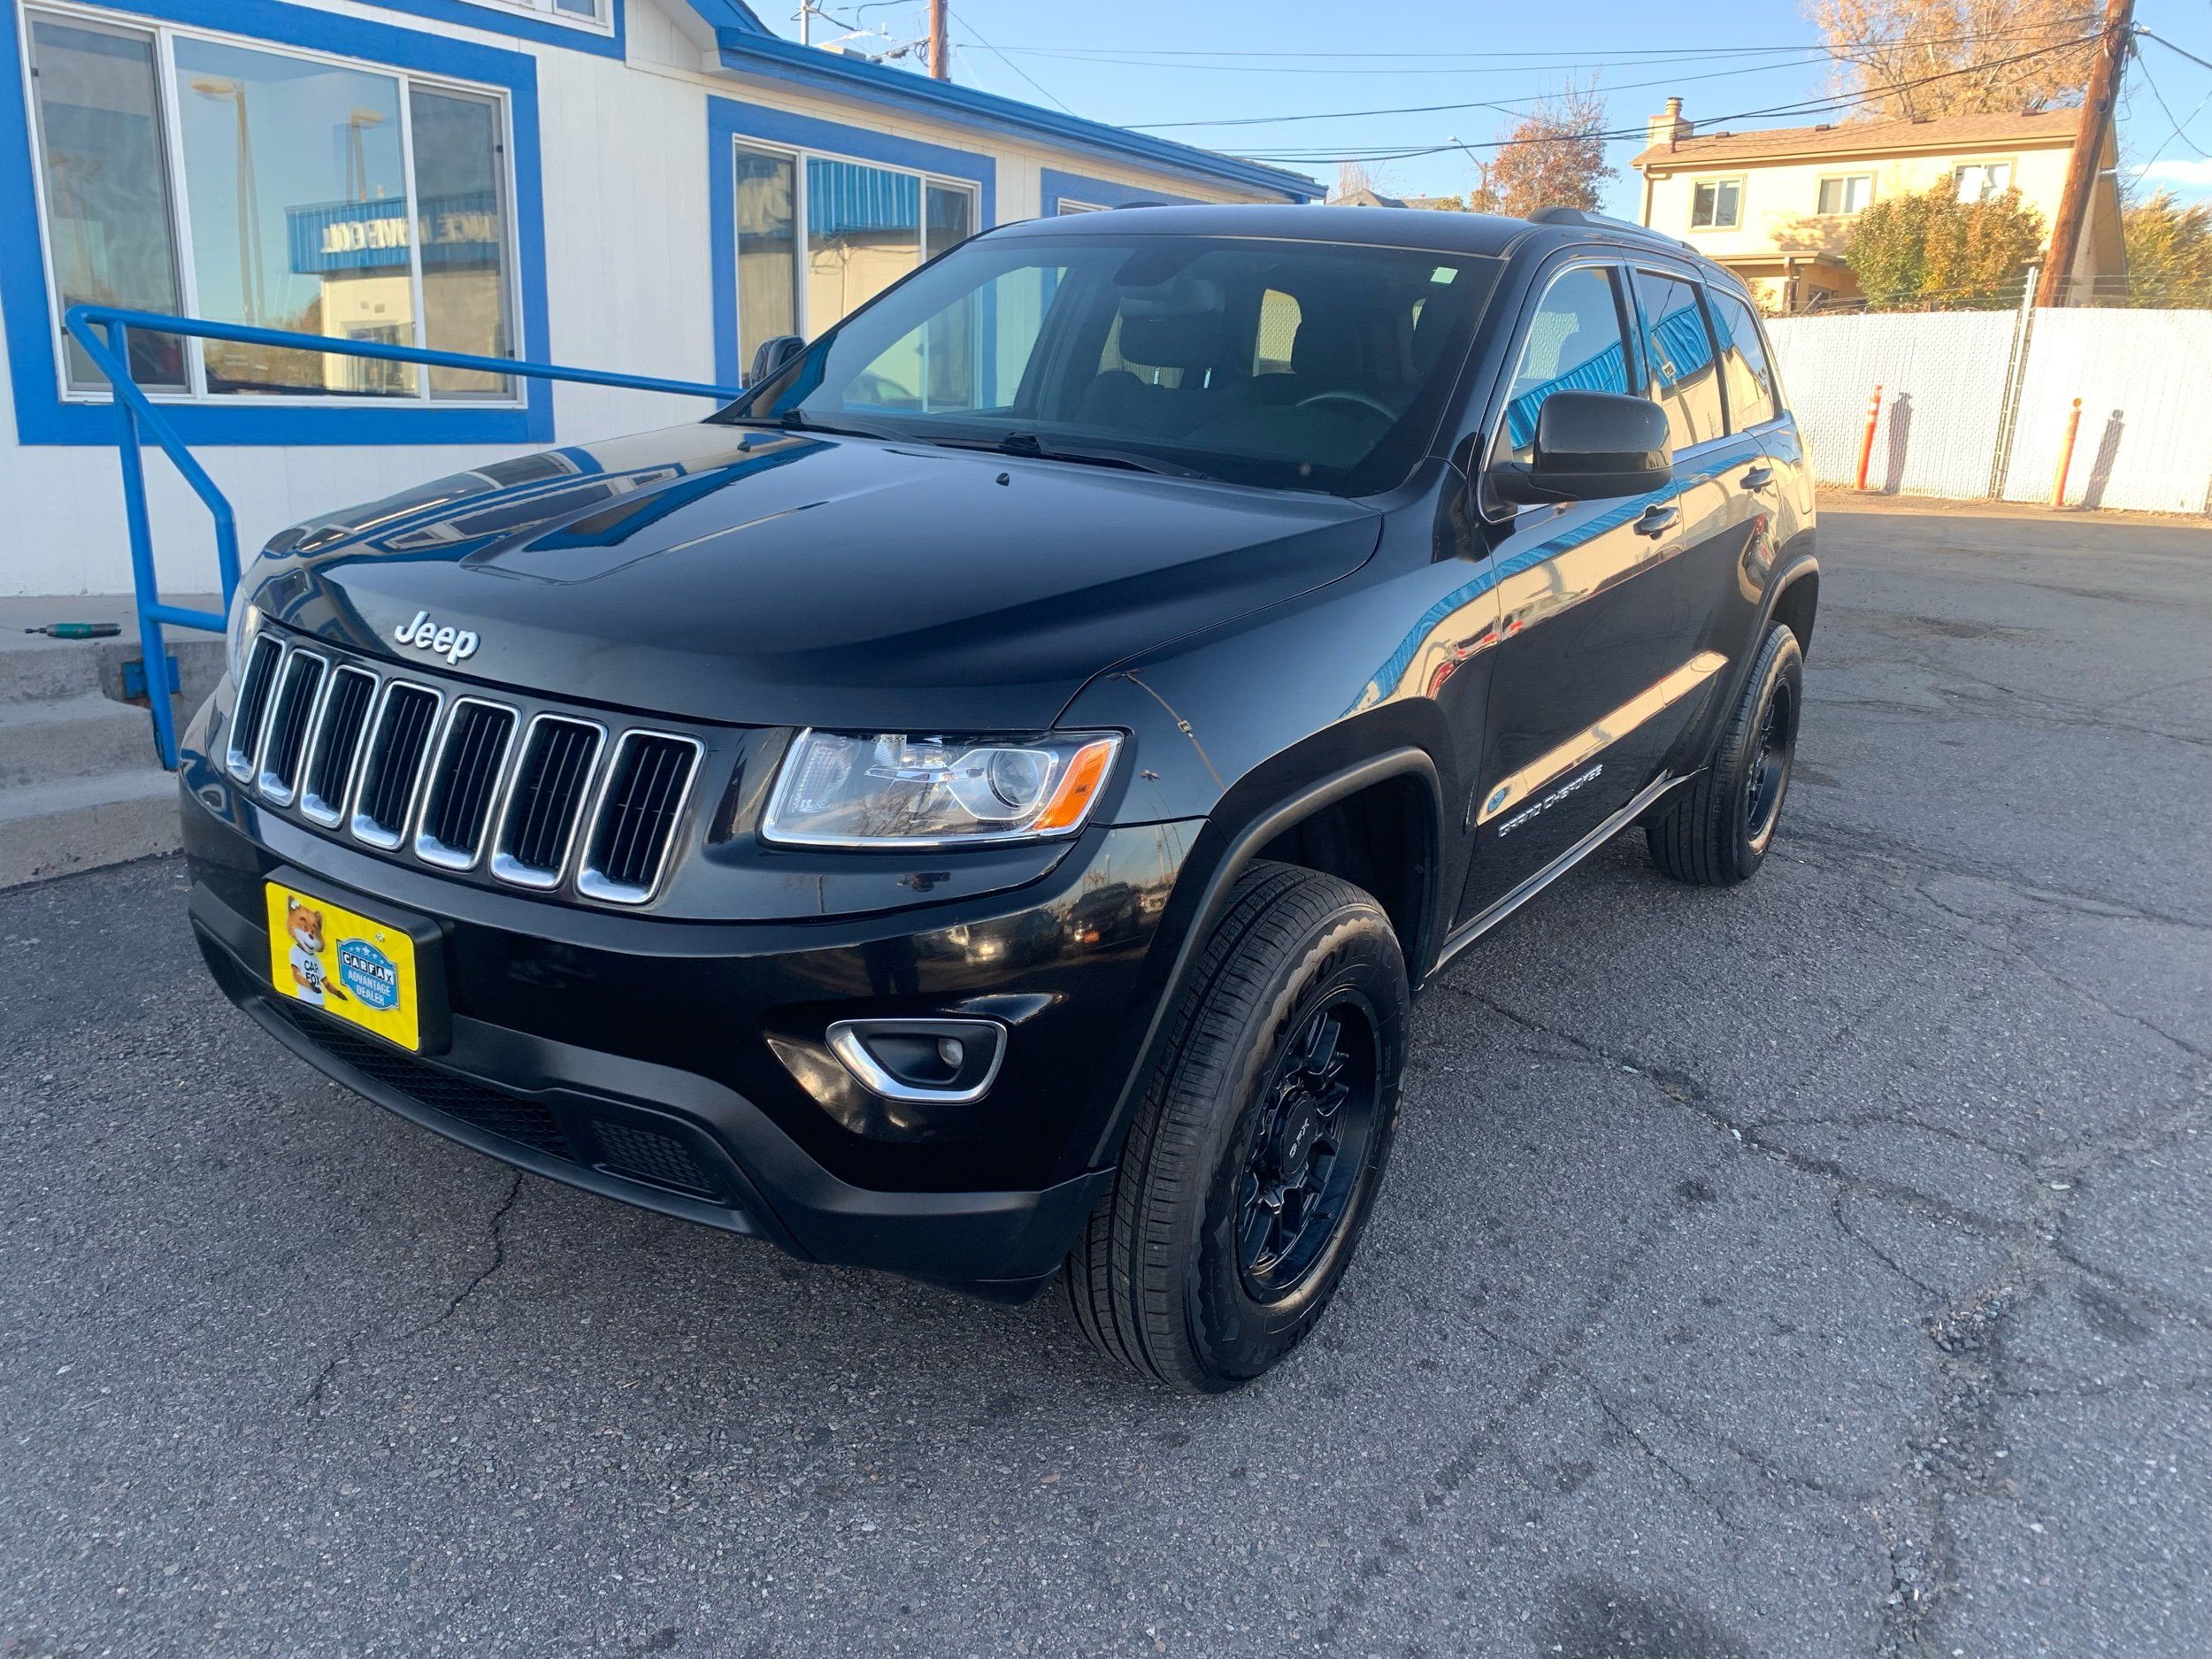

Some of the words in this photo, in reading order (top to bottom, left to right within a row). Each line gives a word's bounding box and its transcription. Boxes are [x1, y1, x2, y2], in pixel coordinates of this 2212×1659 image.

[395, 611, 480, 665] Jeep
[343, 952, 394, 985] CARFAX
[348, 970, 391, 995] ADVANTAGE
[356, 985, 385, 1005] DEALER
